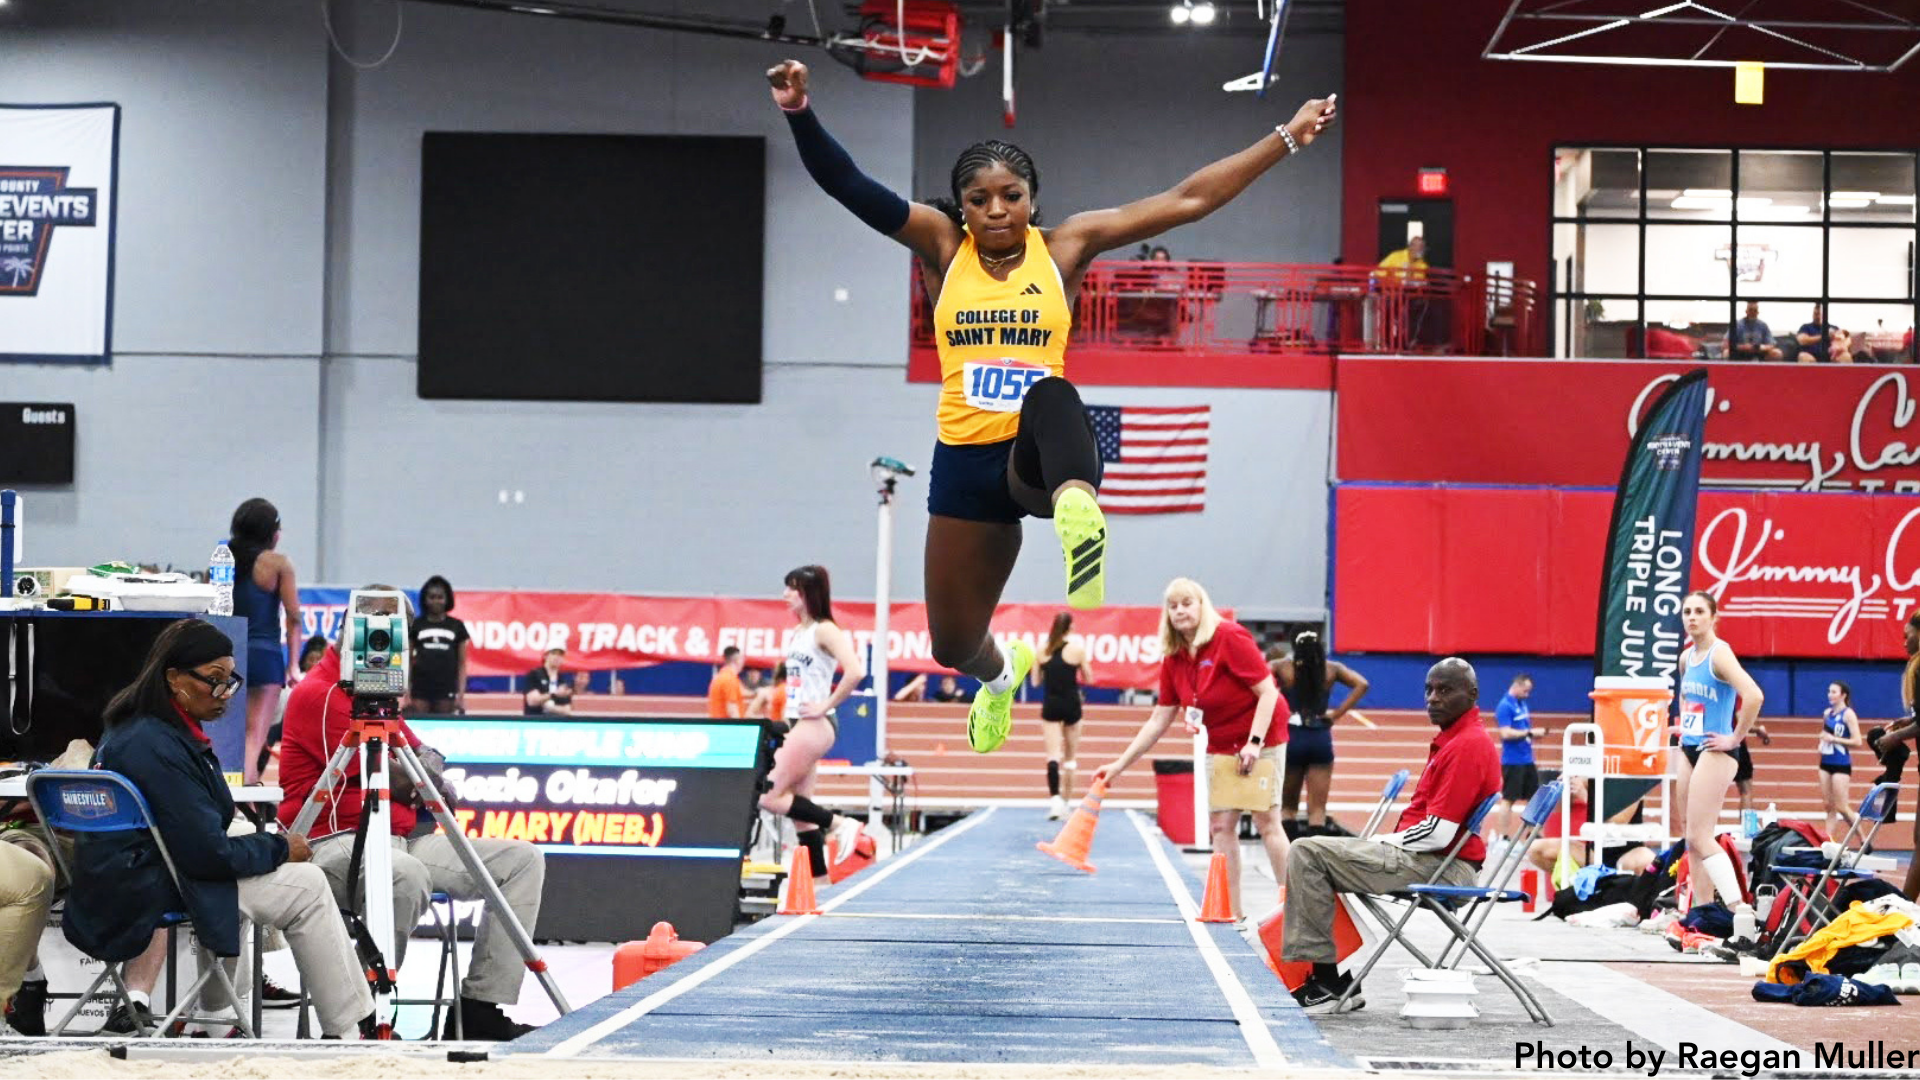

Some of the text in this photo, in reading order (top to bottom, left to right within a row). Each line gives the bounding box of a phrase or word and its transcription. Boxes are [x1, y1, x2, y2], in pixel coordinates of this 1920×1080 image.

[0, 195, 89, 218] EVENTS
[0, 220, 34, 241] ER
[956, 309, 1039, 324] COLLEGE OF
[946, 327, 1052, 347] SAINT MARY
[971, 366, 1044, 401] 1055
[1620, 516, 1655, 678] TRIPLE JUM
[1652, 530, 1683, 687] LONG JUM
[463, 620, 569, 650] NDOOR
[577, 623, 679, 654] TRACK
[684, 626, 710, 656] &
[62, 792, 106, 806] GAINESVILLE
[545, 768, 677, 806] Okafor
[483, 809, 573, 842] MARY
[572, 809, 664, 848] (NEB.)
